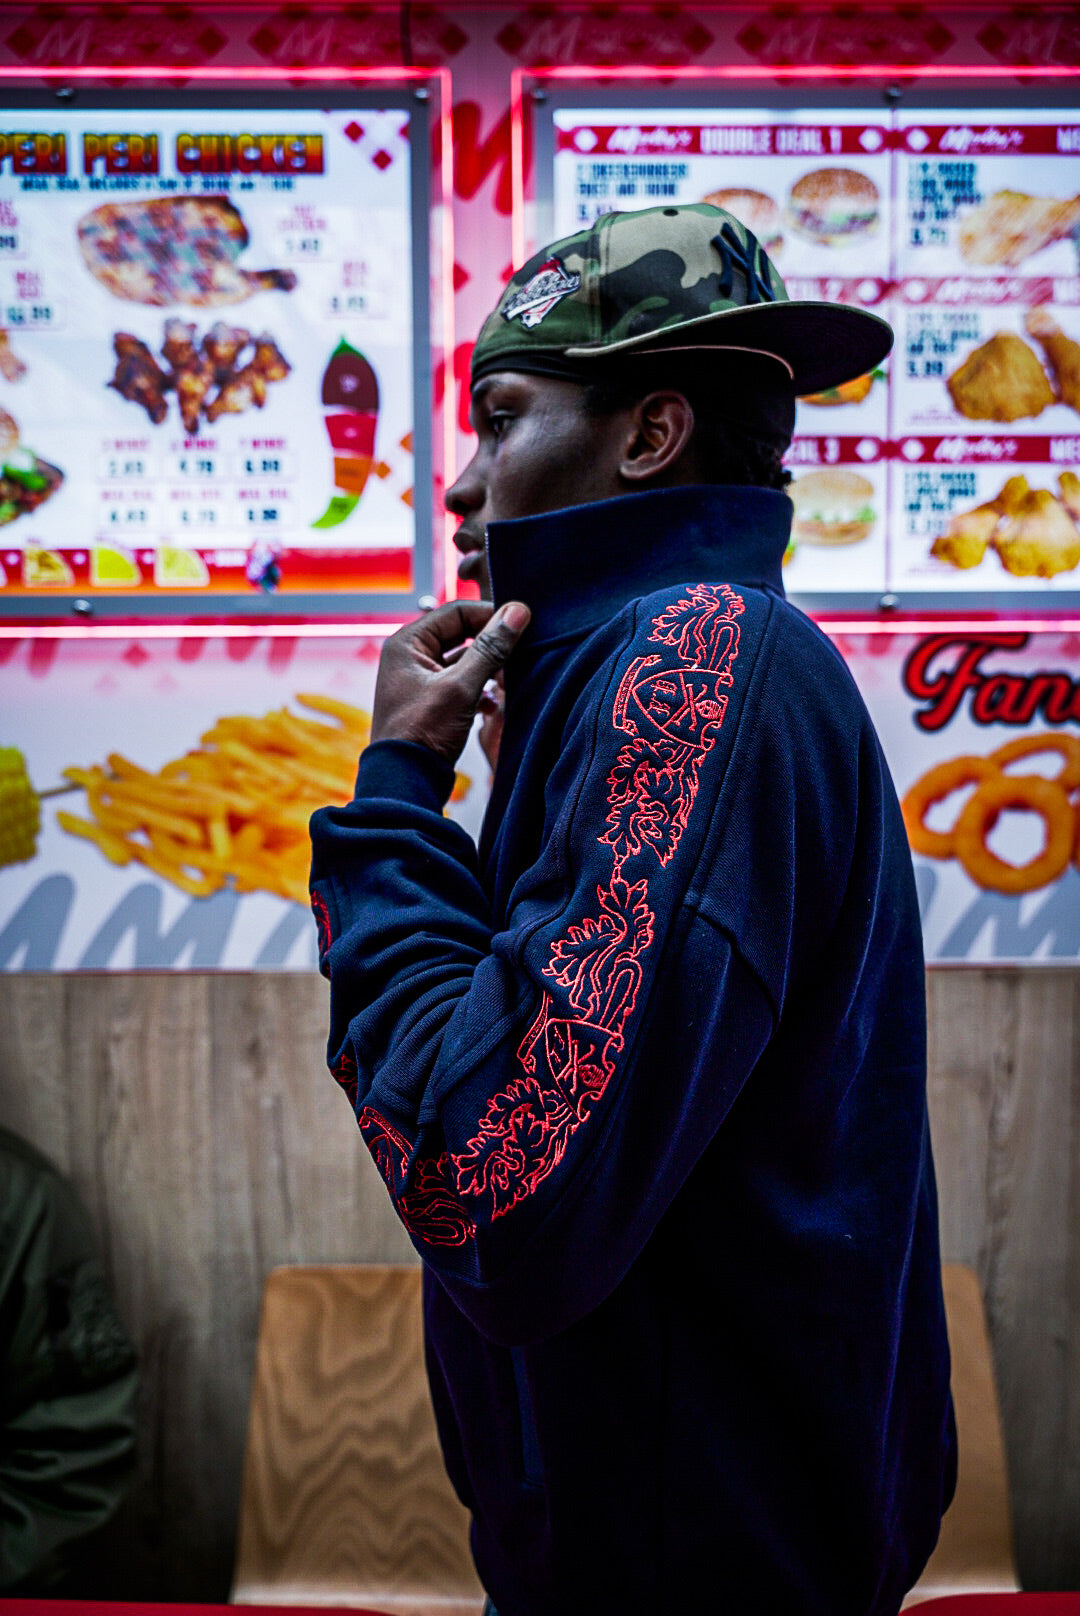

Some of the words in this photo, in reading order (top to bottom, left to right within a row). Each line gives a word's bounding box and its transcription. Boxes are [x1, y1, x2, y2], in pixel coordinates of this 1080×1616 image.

[84, 133, 159, 175] PERI
[176, 133, 324, 175] CHICKEN
[903, 631, 1080, 734] Fan
